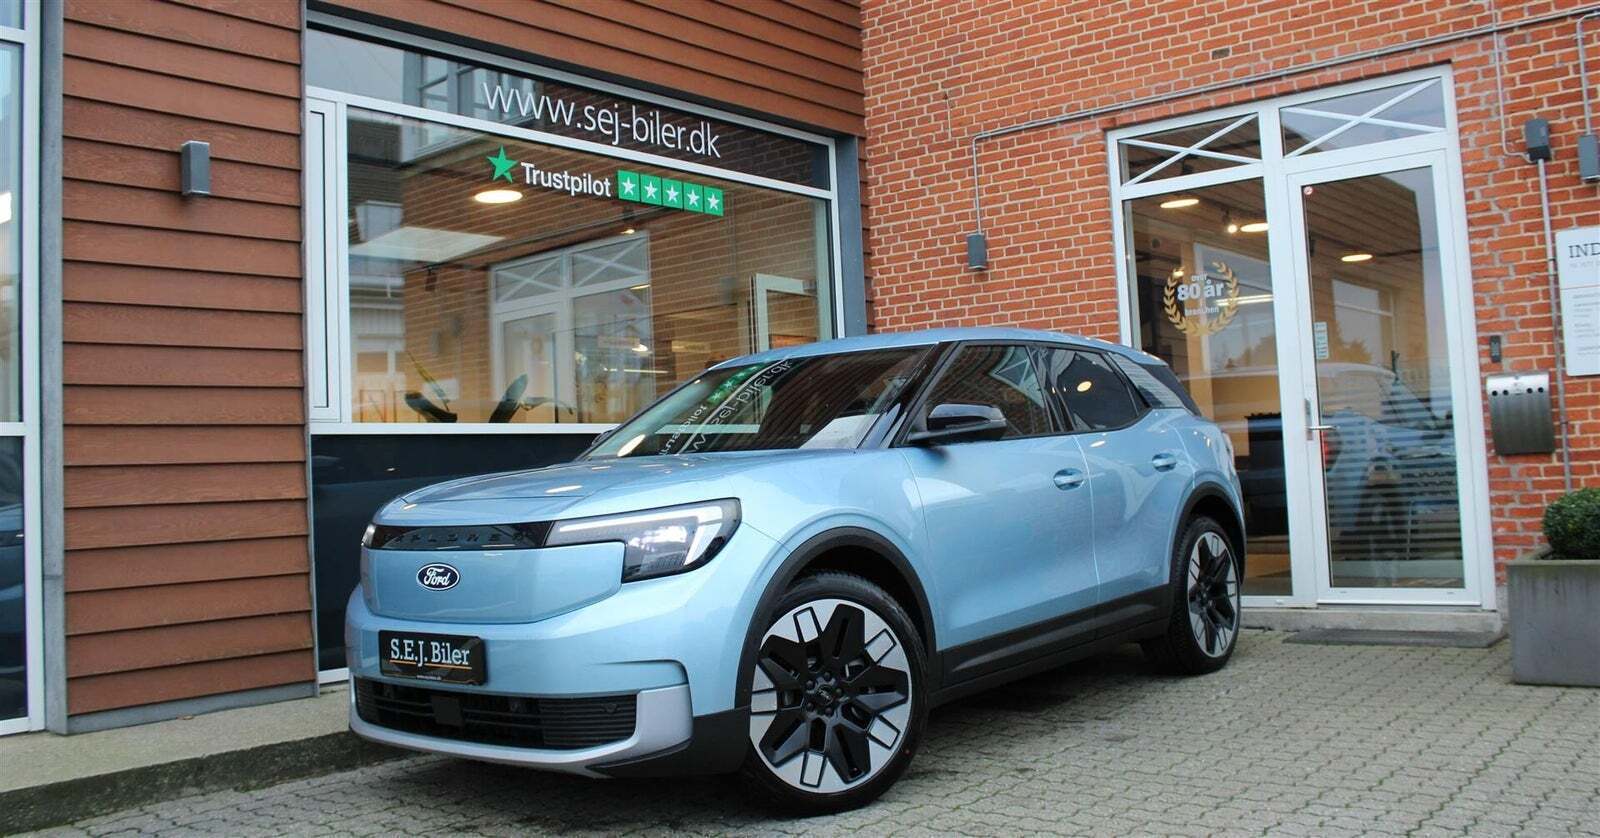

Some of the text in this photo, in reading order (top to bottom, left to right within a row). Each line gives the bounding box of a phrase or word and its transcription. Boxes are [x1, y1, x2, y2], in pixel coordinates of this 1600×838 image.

[483, 82, 721, 158] www.sej-biler.dk
[521, 162, 611, 197] Trustpilot
[1177, 279, 1224, 301] 80 år
[423, 567, 451, 586] Ford
[390, 638, 470, 667] S.E.J. Biler
